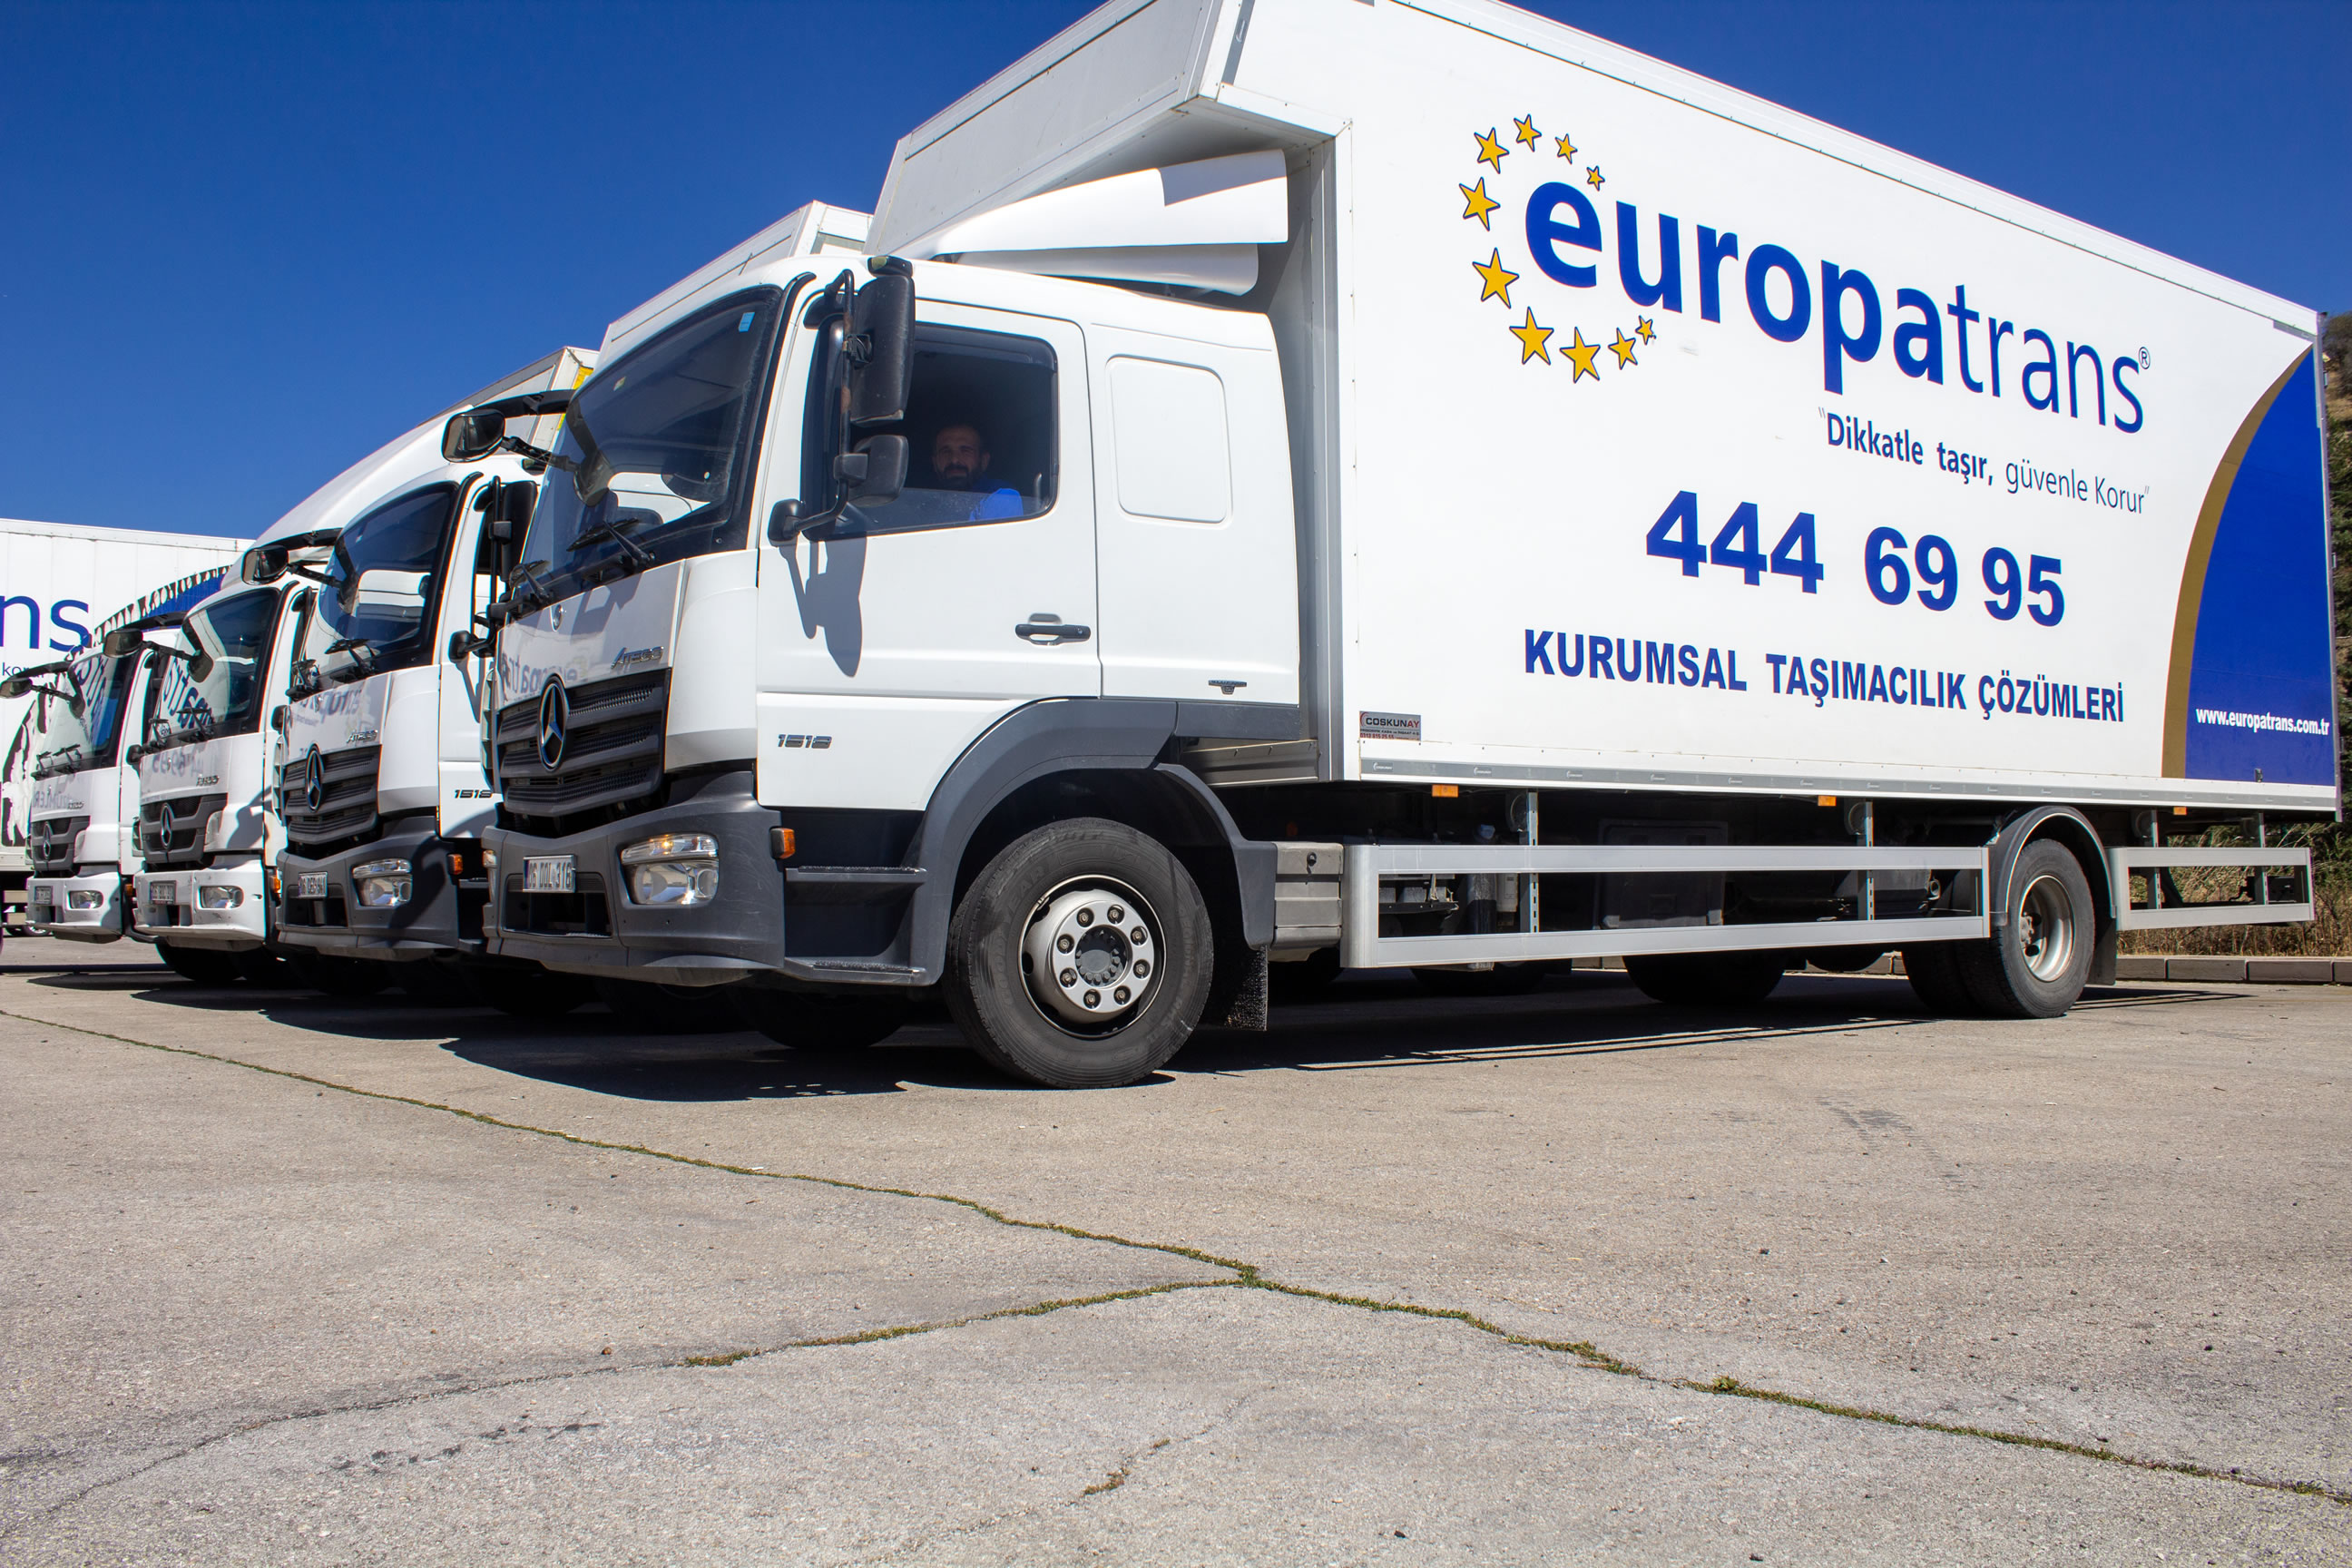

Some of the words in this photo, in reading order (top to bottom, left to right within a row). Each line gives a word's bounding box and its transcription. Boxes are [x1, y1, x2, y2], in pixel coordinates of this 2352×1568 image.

[1936, 441, 1994, 486] taşır,
[2005, 458, 2088, 501] güvenle
[1646, 490, 1824, 594] 444
[1865, 526, 1958, 612] 69
[1982, 546, 2065, 627] 95
[1524, 629, 1747, 691] KURUMSAL
[1766, 652, 1966, 709] TAŞIMACILIK
[1978, 670, 2124, 722] ÇÖZÜMLERİ
[2195, 708, 2330, 736] www.europatrans.com.tr
